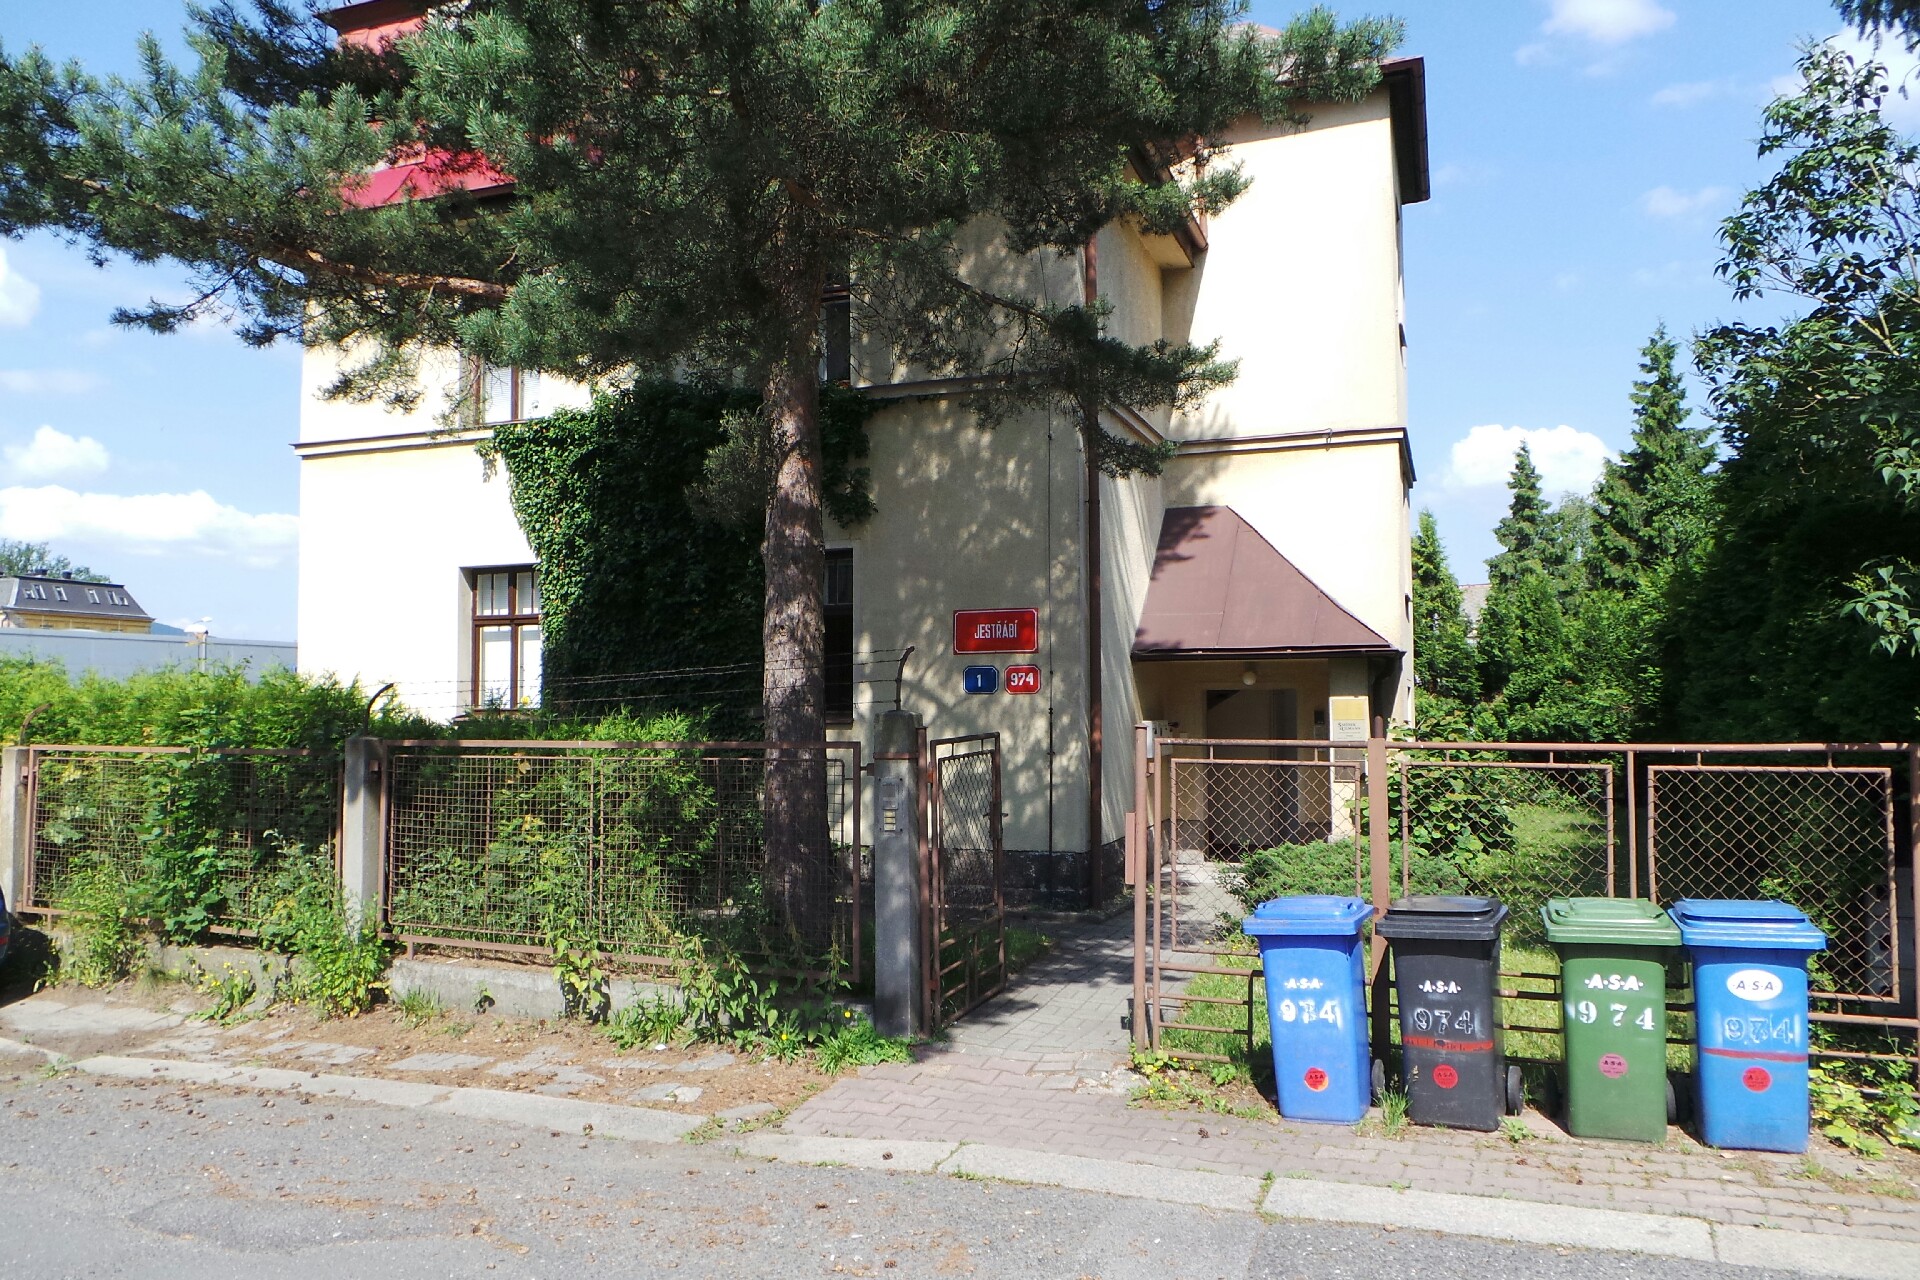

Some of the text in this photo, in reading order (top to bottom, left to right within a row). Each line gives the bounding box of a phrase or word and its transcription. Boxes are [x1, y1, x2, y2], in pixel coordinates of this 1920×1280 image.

[974, 620, 1018, 639] JESTŘÁBÍ
[976, 674, 982, 688] 1
[1010, 672, 1034, 686] 974
[1280, 999, 1337, 1024] 974
[1414, 1007, 1474, 1035] 974
[1578, 1001, 1655, 1030] 974
